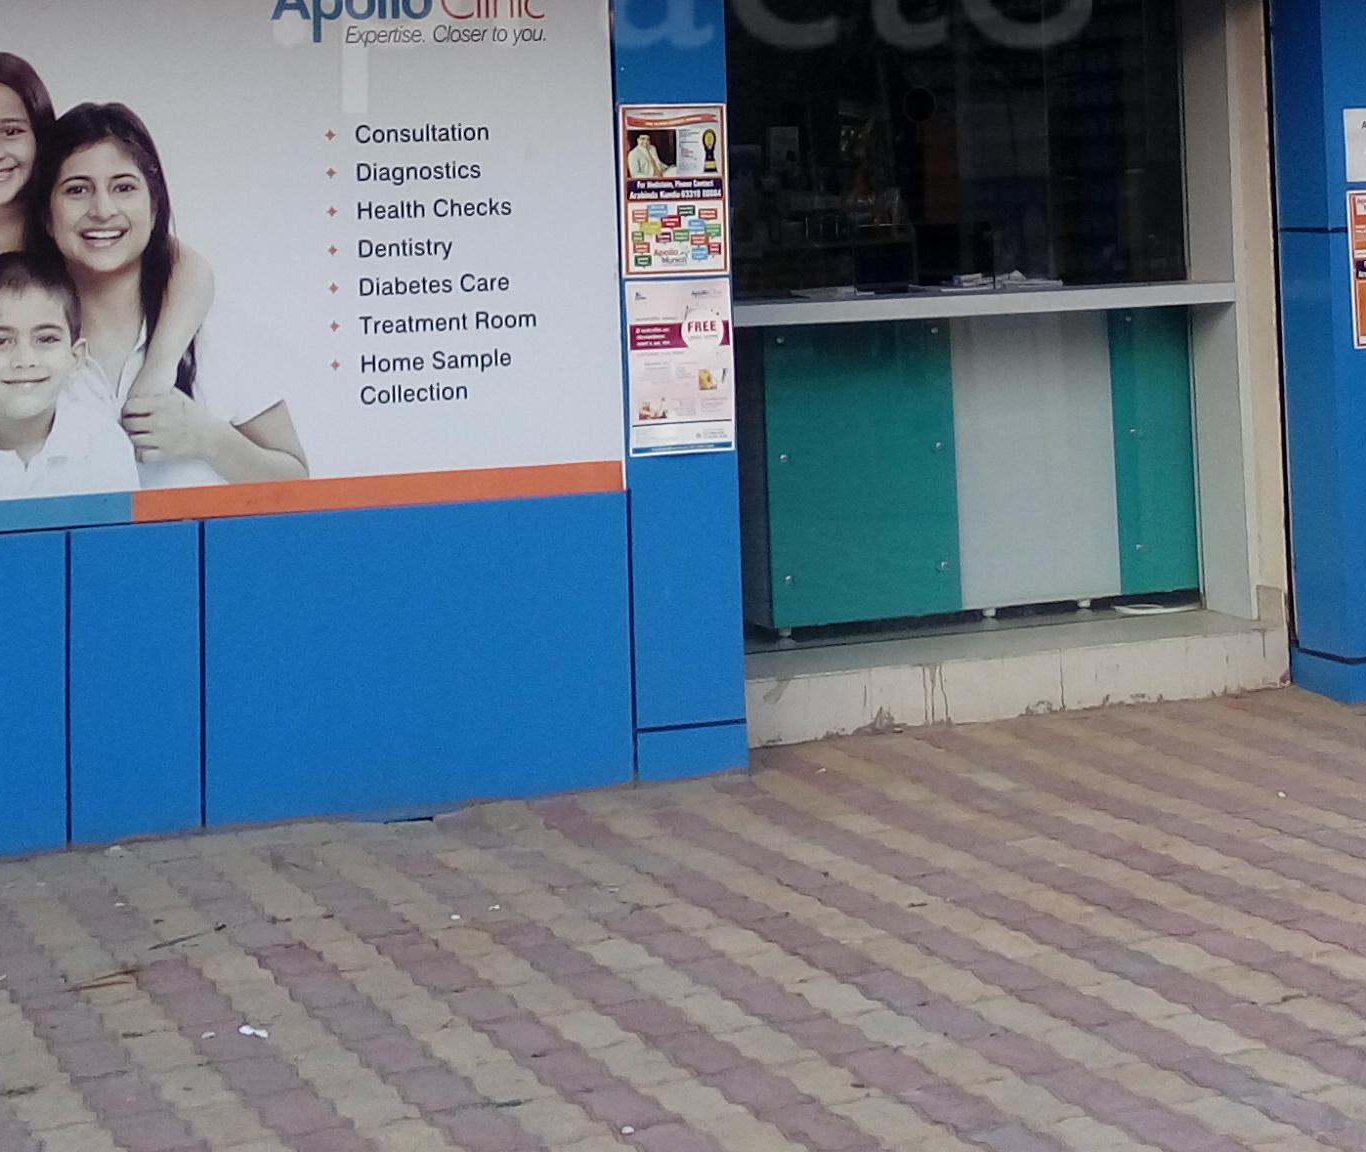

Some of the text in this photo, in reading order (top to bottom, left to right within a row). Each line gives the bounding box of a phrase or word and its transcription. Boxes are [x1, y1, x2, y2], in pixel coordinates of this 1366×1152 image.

[346, 25, 547, 47] Expertise. Closer to you.
[355, 124, 490, 144] Consultation
[356, 161, 481, 185] Diagnostics
[357, 198, 512, 220] Health Checks
[358, 238, 452, 260] Dentistry
[359, 274, 510, 297] Diabetes Care
[359, 311, 537, 334] Treatment Room
[688, 320, 716, 332] FREE
[361, 349, 512, 373] Home Sample
[361, 383, 467, 405] Collection
